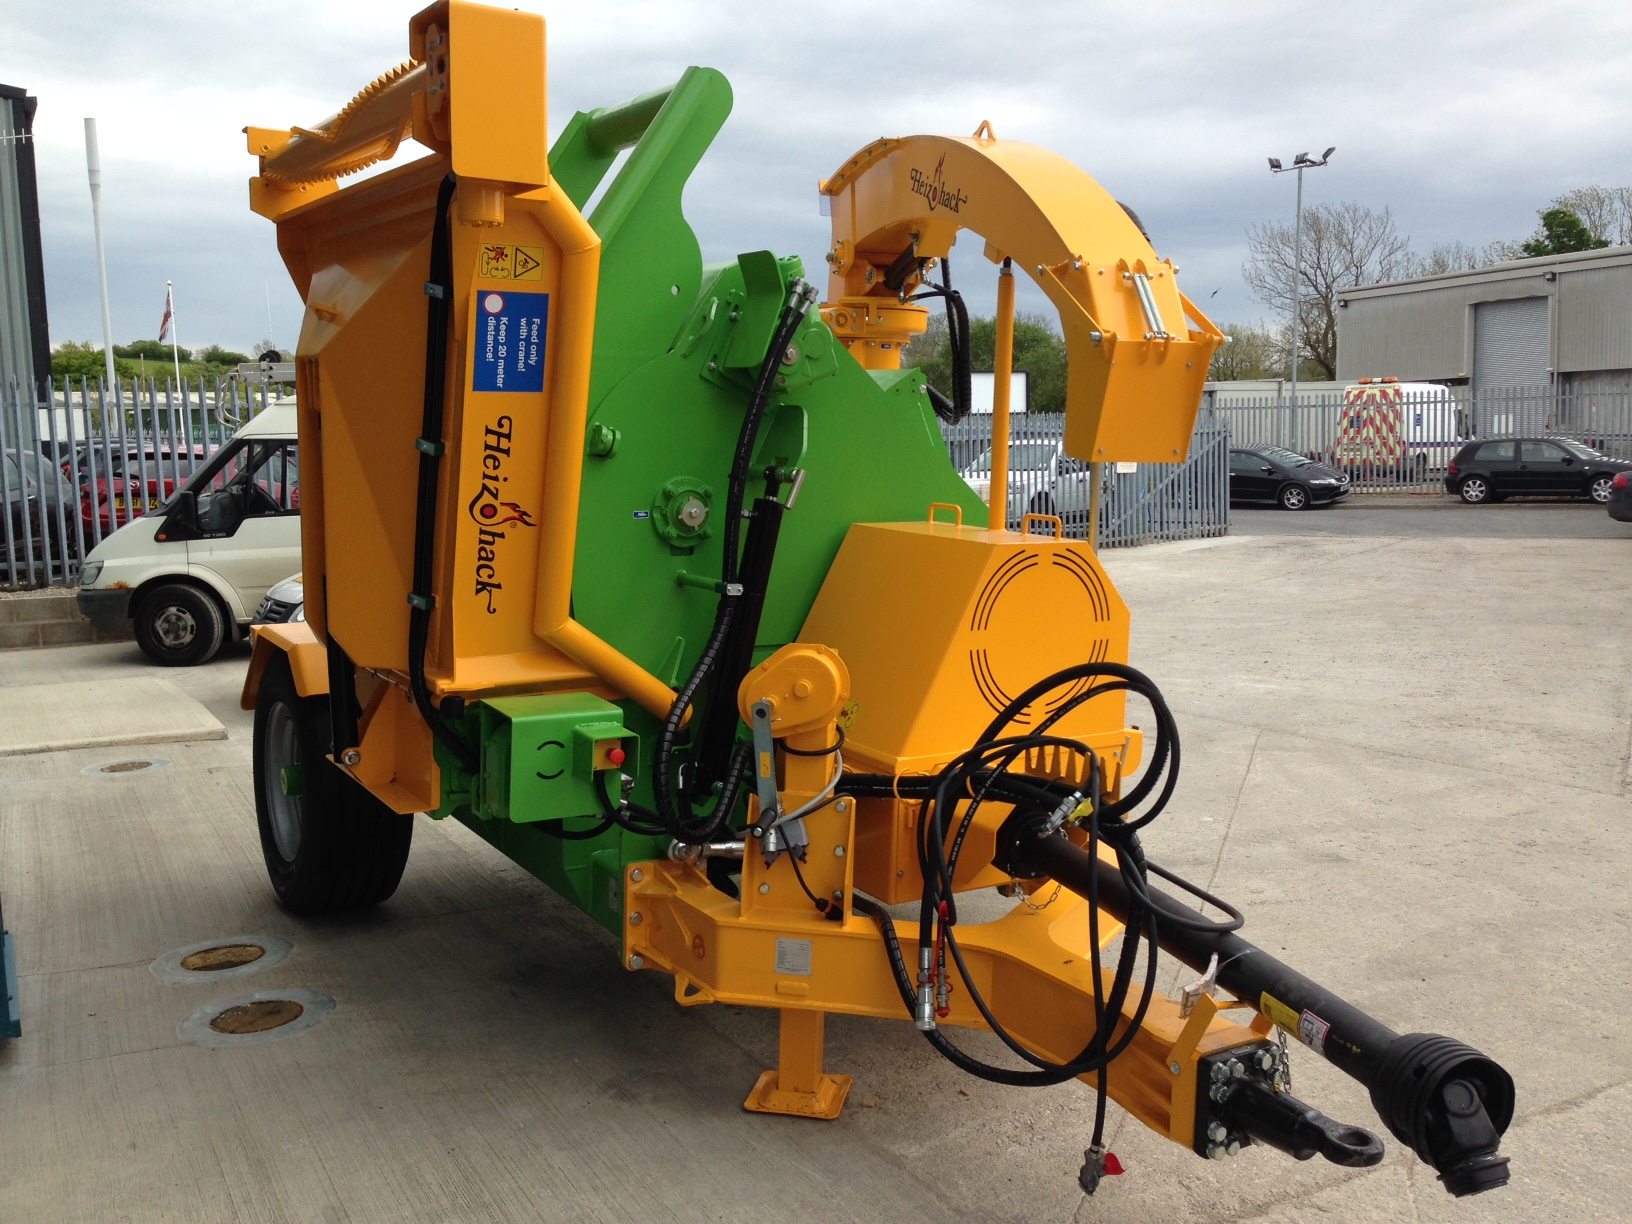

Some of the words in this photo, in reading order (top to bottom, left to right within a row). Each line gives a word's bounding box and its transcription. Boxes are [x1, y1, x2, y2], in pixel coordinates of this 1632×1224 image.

[910, 167, 968, 213] Heizohack
[486, 316, 496, 362] distance!
[497, 317, 508, 343] Keep
[519, 318, 528, 339] with
[530, 318, 540, 343] Feed
[498, 345, 507, 357] 20
[517, 341, 526, 372] crane!
[528, 345, 538, 366] only
[496, 359, 505, 388] meter
[469, 415, 514, 615] Heizohack
